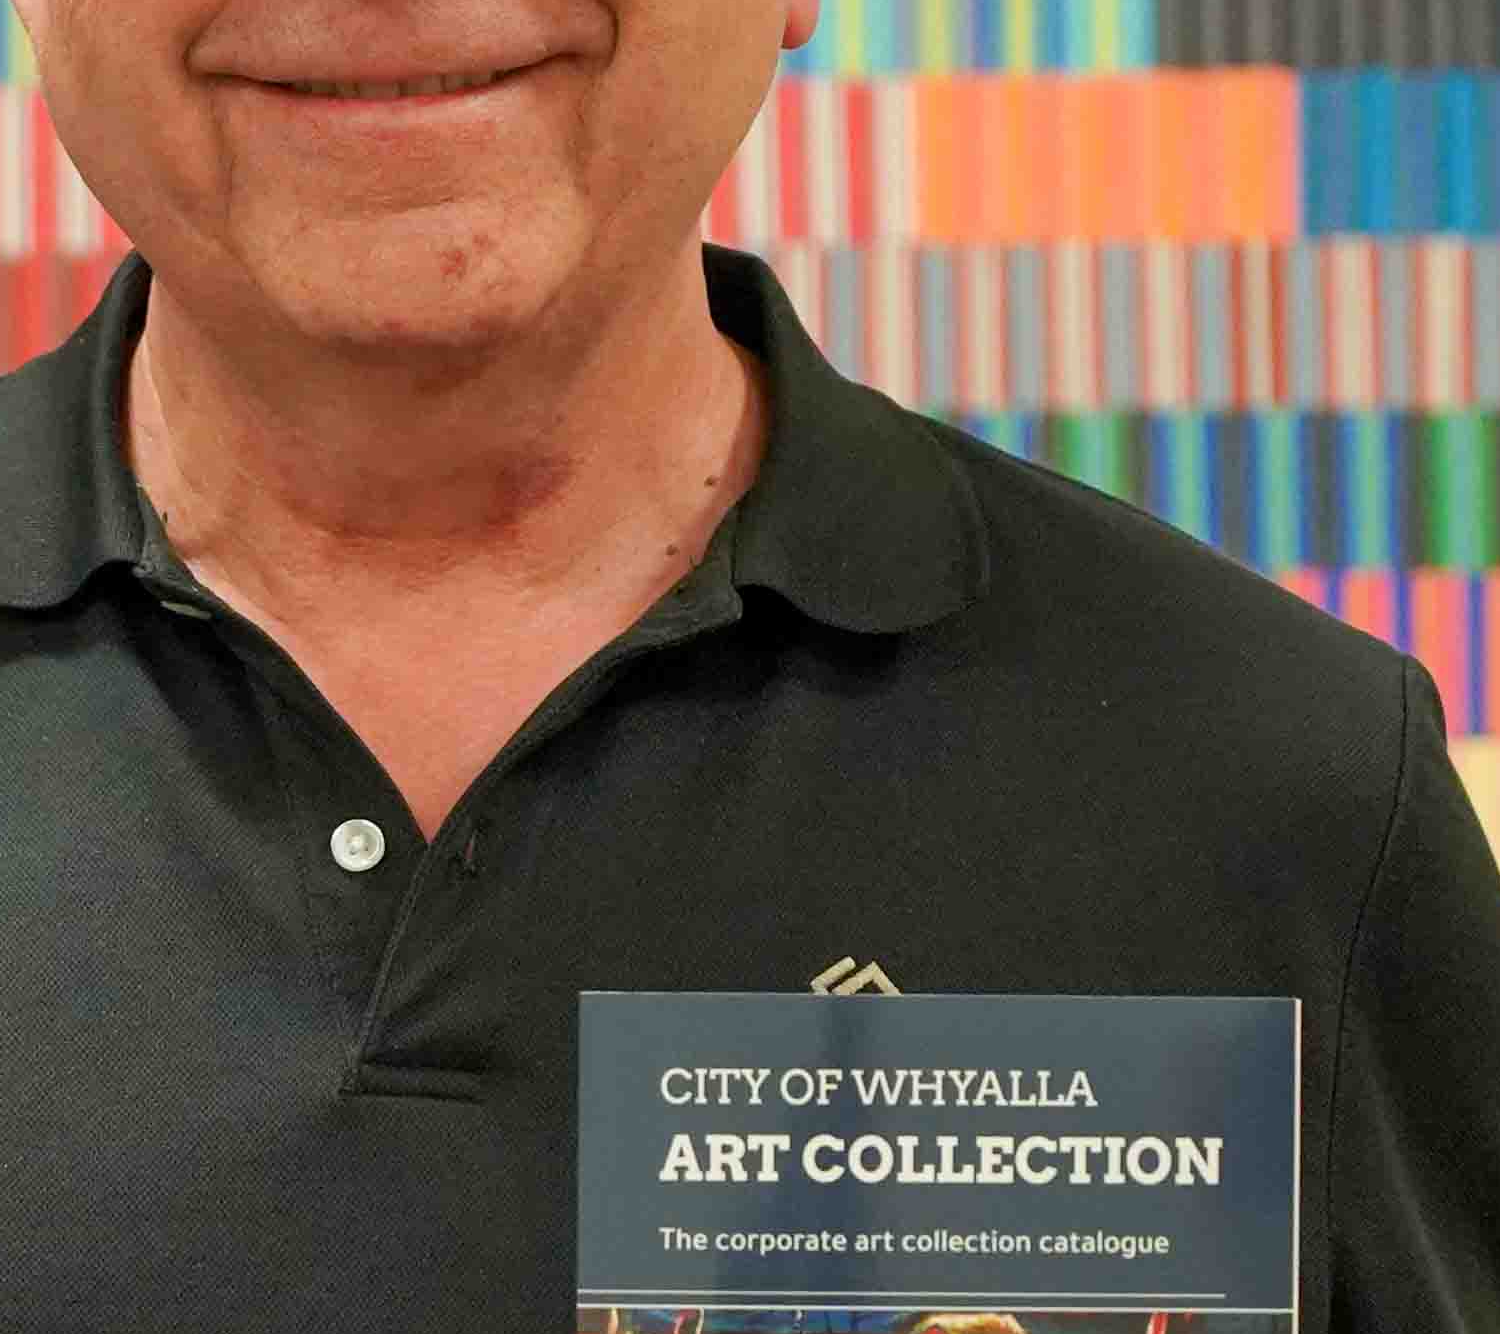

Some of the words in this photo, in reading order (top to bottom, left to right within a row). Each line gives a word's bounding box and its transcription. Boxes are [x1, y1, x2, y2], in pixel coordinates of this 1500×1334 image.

[660, 1067, 772, 1105] CITY
[779, 1067, 843, 1106] OF
[850, 1068, 1099, 1108] WHYALLA
[658, 1133, 791, 1183] ART
[801, 1133, 1224, 1186] COLLECTION
[658, 1226, 709, 1251] The
[714, 1230, 848, 1257] corporate
[853, 1230, 895, 1252] art
[901, 1229, 1032, 1254] collection
[1039, 1230, 1170, 1260] catalogue
